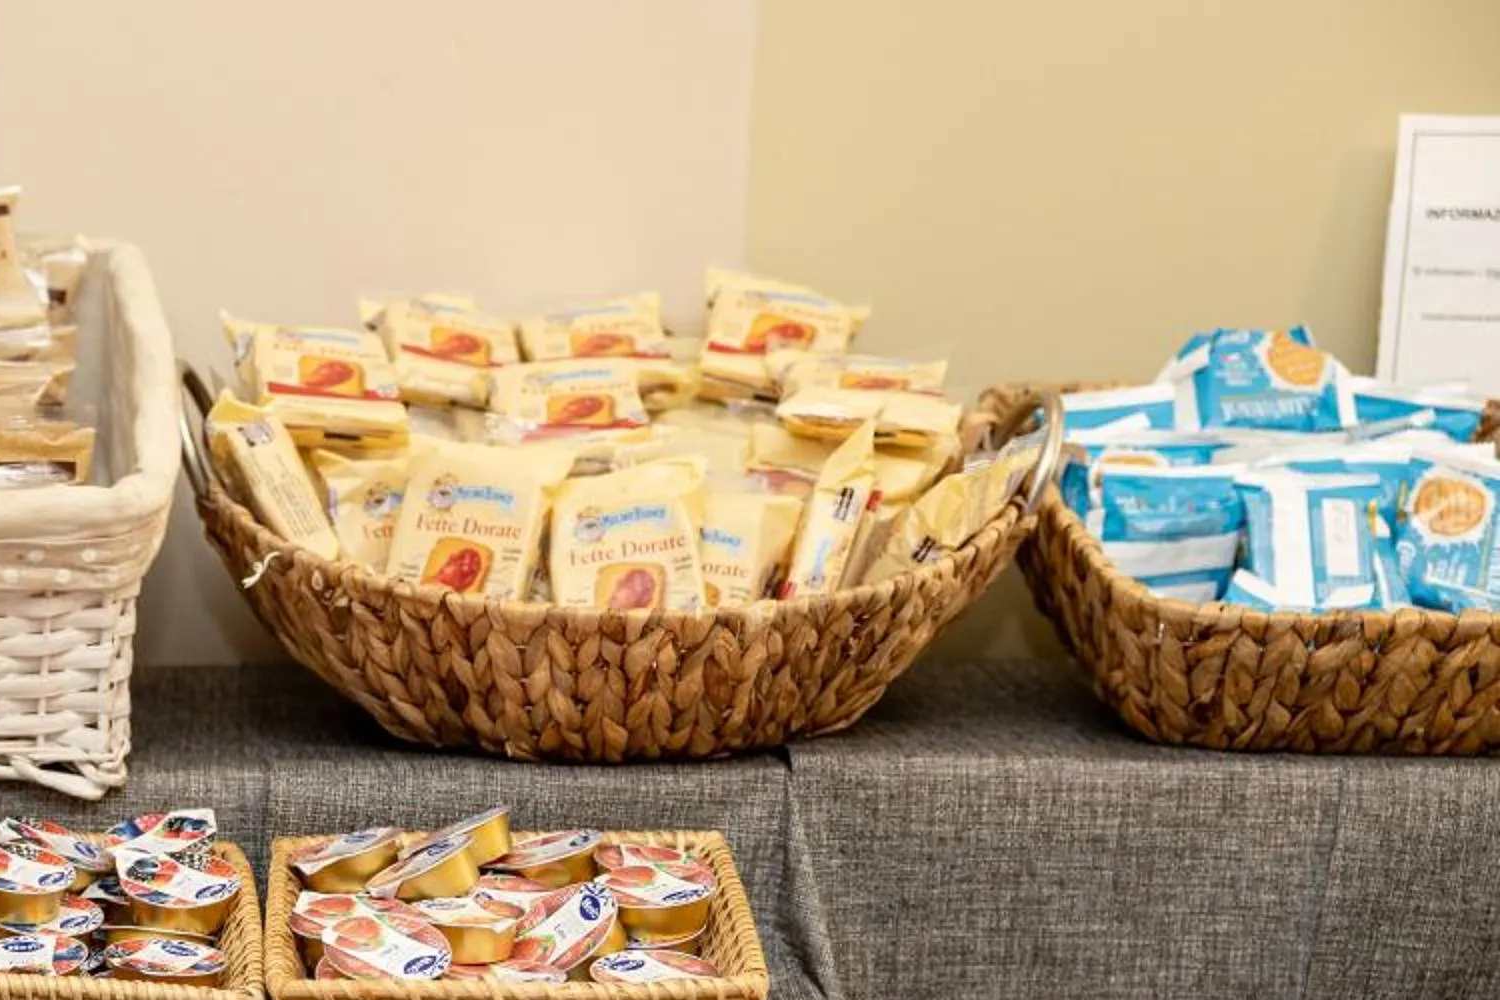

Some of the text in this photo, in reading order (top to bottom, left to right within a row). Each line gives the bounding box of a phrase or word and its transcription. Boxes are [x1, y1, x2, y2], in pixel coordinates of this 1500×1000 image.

[416, 513, 523, 540] Fette Dorate
[620, 533, 687, 558] Dorate
[701, 560, 751, 579] orate
